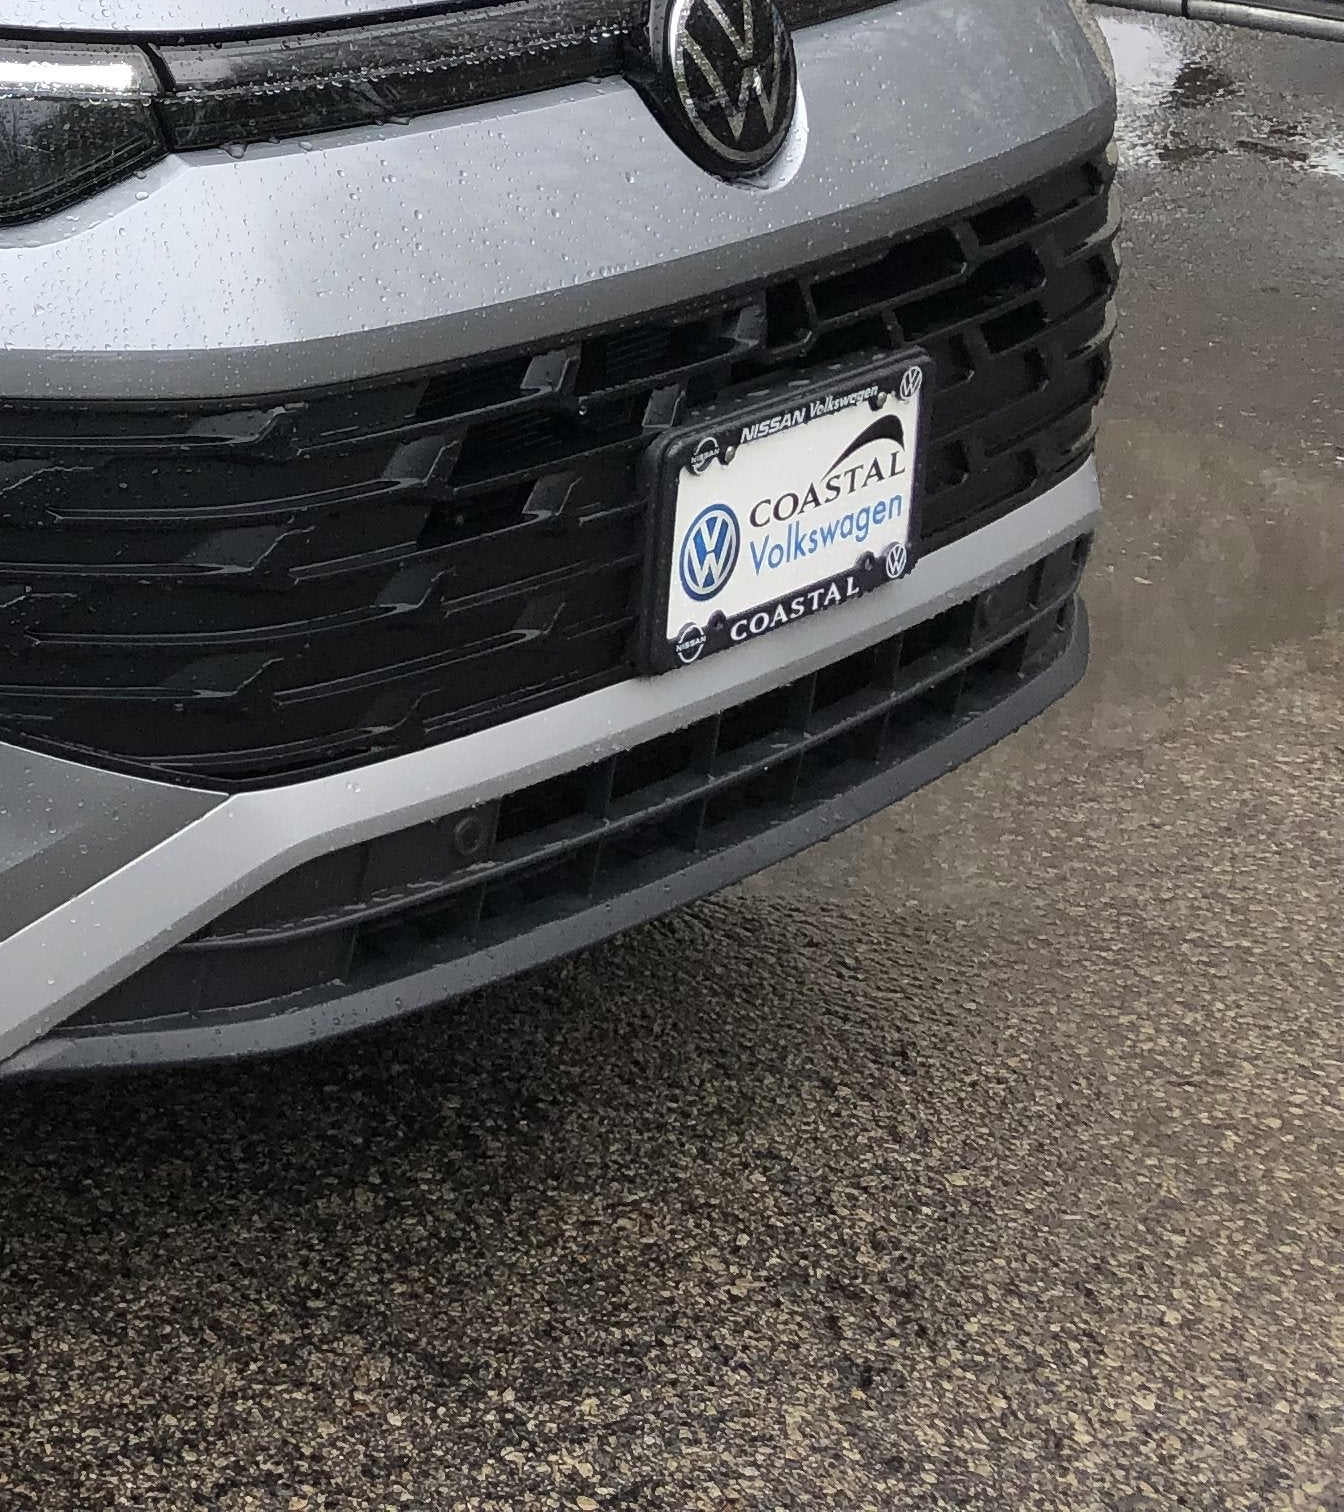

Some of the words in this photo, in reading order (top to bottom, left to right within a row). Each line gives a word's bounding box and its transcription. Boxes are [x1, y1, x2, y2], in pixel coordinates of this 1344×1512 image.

[740, 408, 807, 443] NISSAN
[810, 385, 879, 419] Volkswagen
[749, 451, 907, 528] COASTAL
[749, 494, 903, 576] Volkswagen
[730, 577, 860, 641] COASTAL
